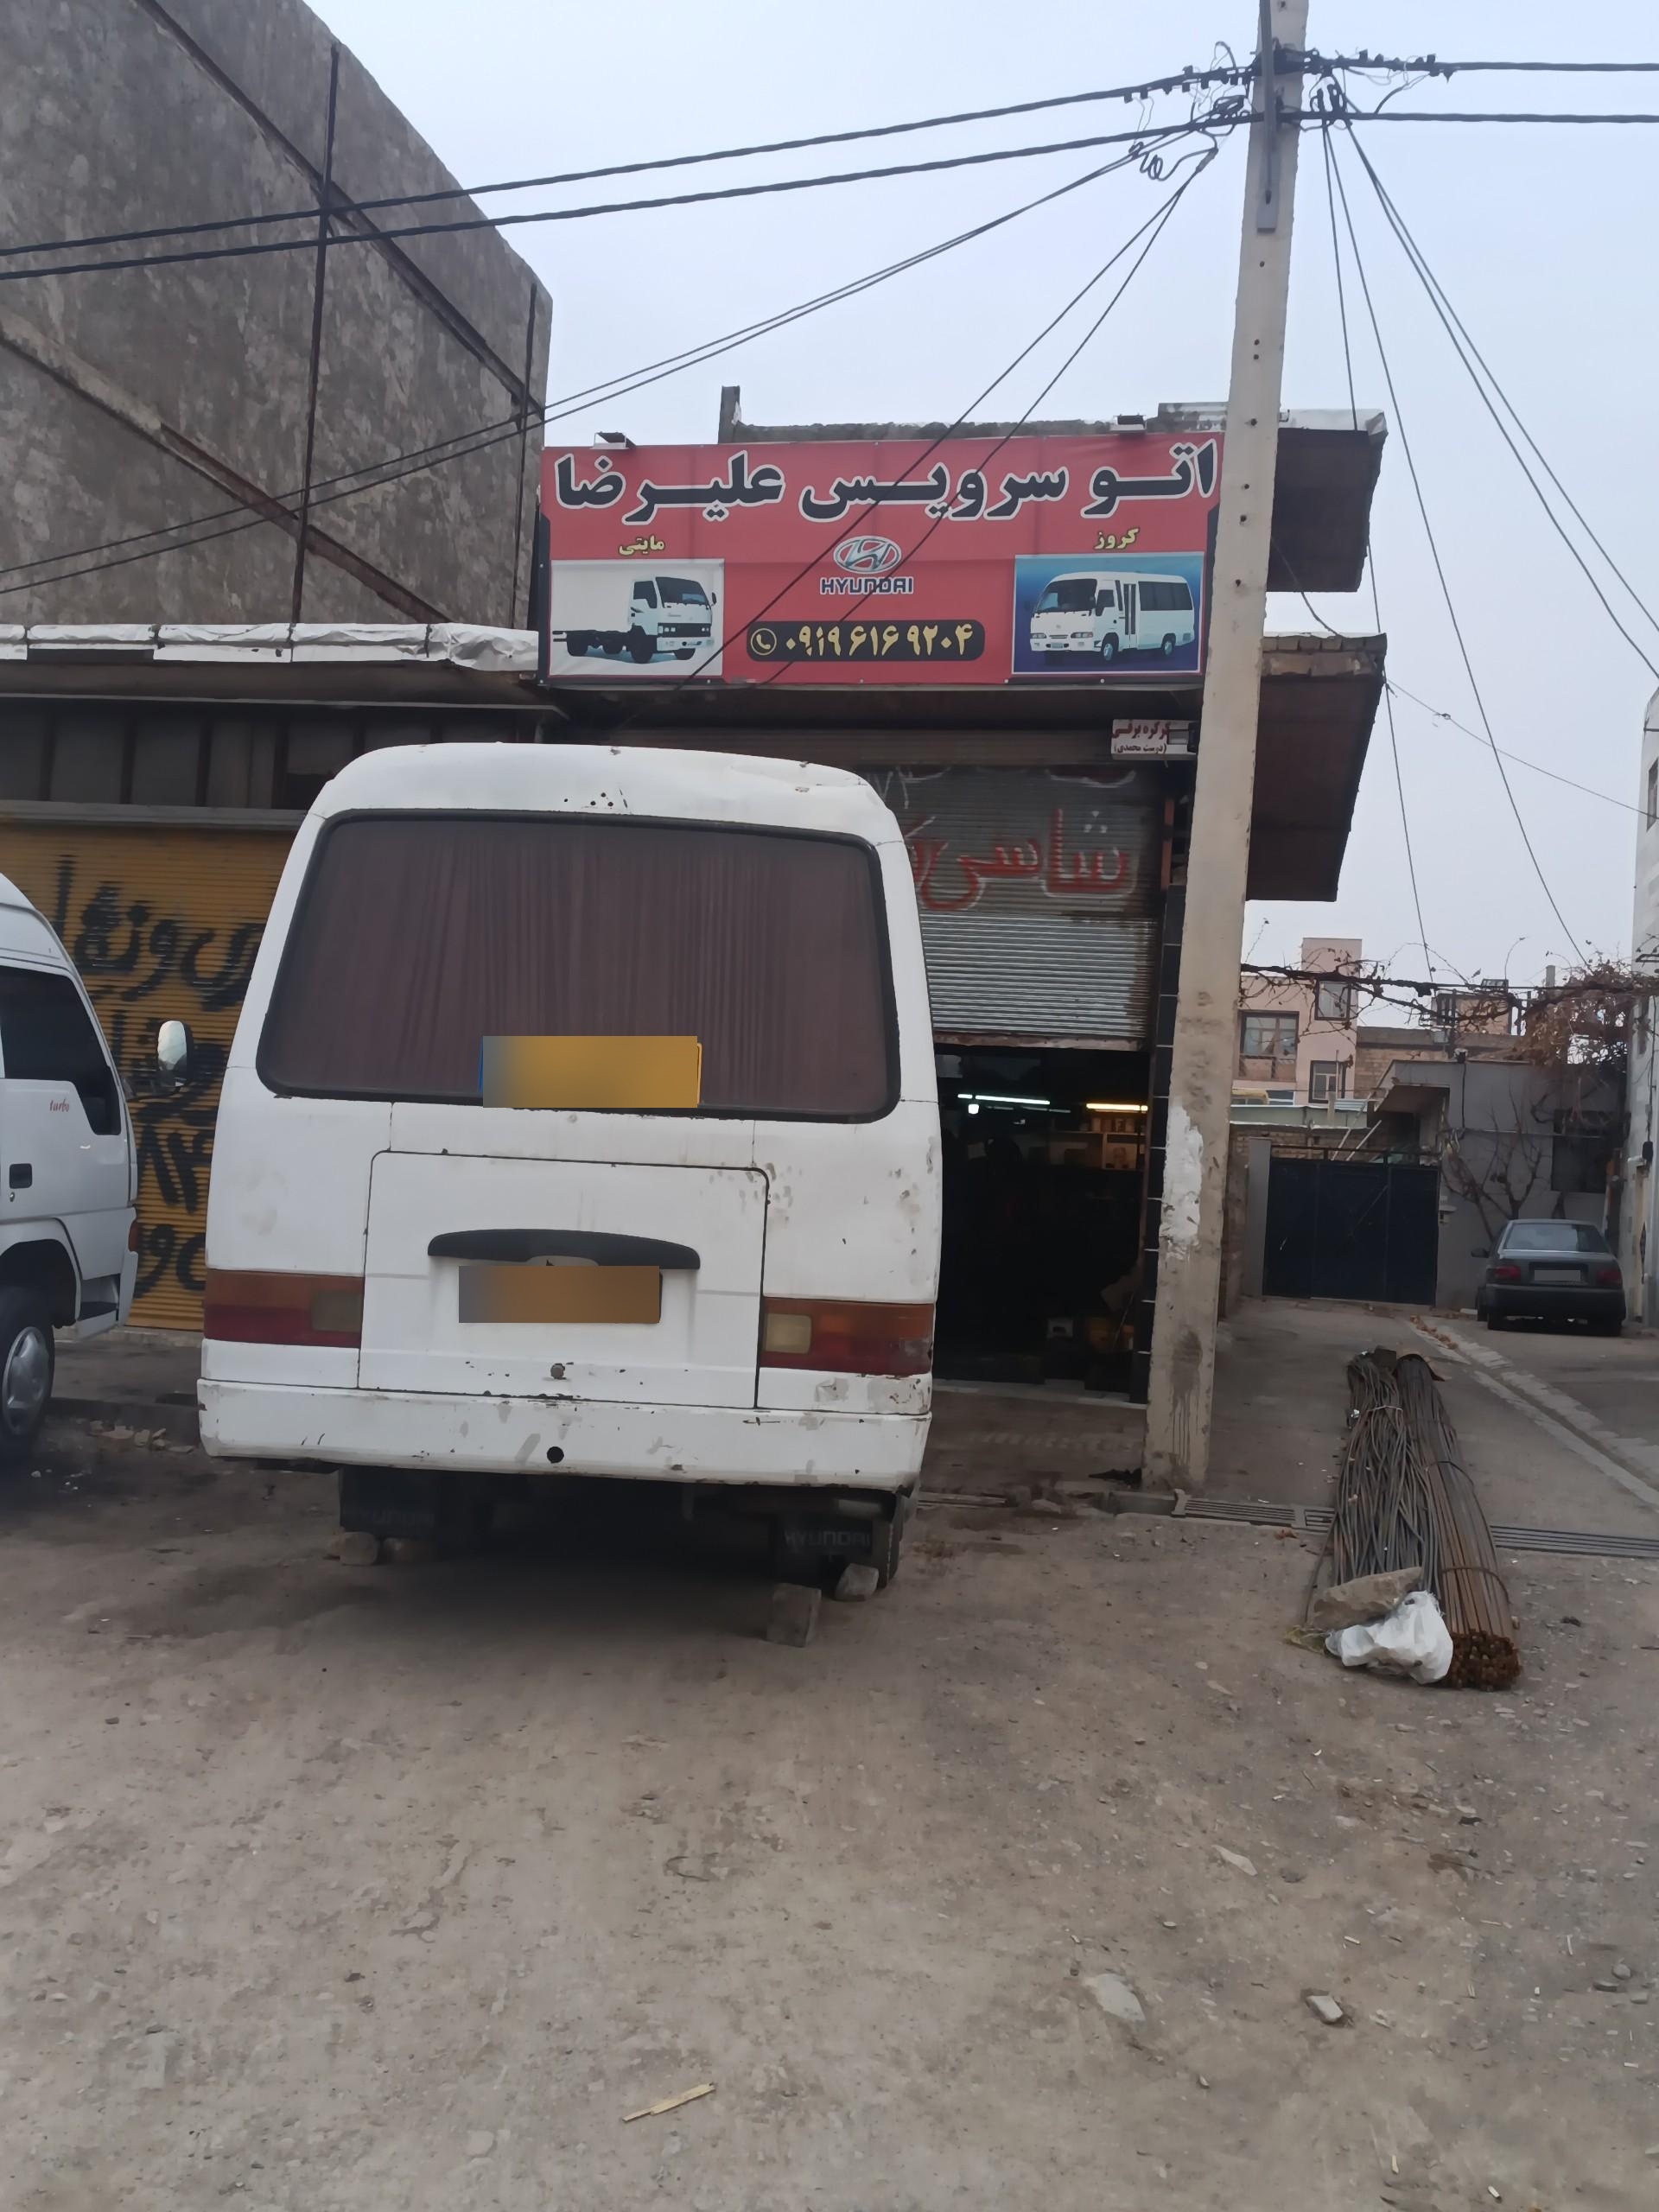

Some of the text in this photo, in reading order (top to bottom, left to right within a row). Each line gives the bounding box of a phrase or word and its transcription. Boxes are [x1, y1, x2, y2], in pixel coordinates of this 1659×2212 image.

[554, 439, 1218, 525] اتو سرویس علیرضا
[618, 535, 665, 556] مایتی
[1093, 527, 1140, 550] کروز
[820, 576, 914, 594] HYUNDAI
[785, 623, 974, 657] ۰۹۱۹ ۶۱۶ ۹۲۰۴
